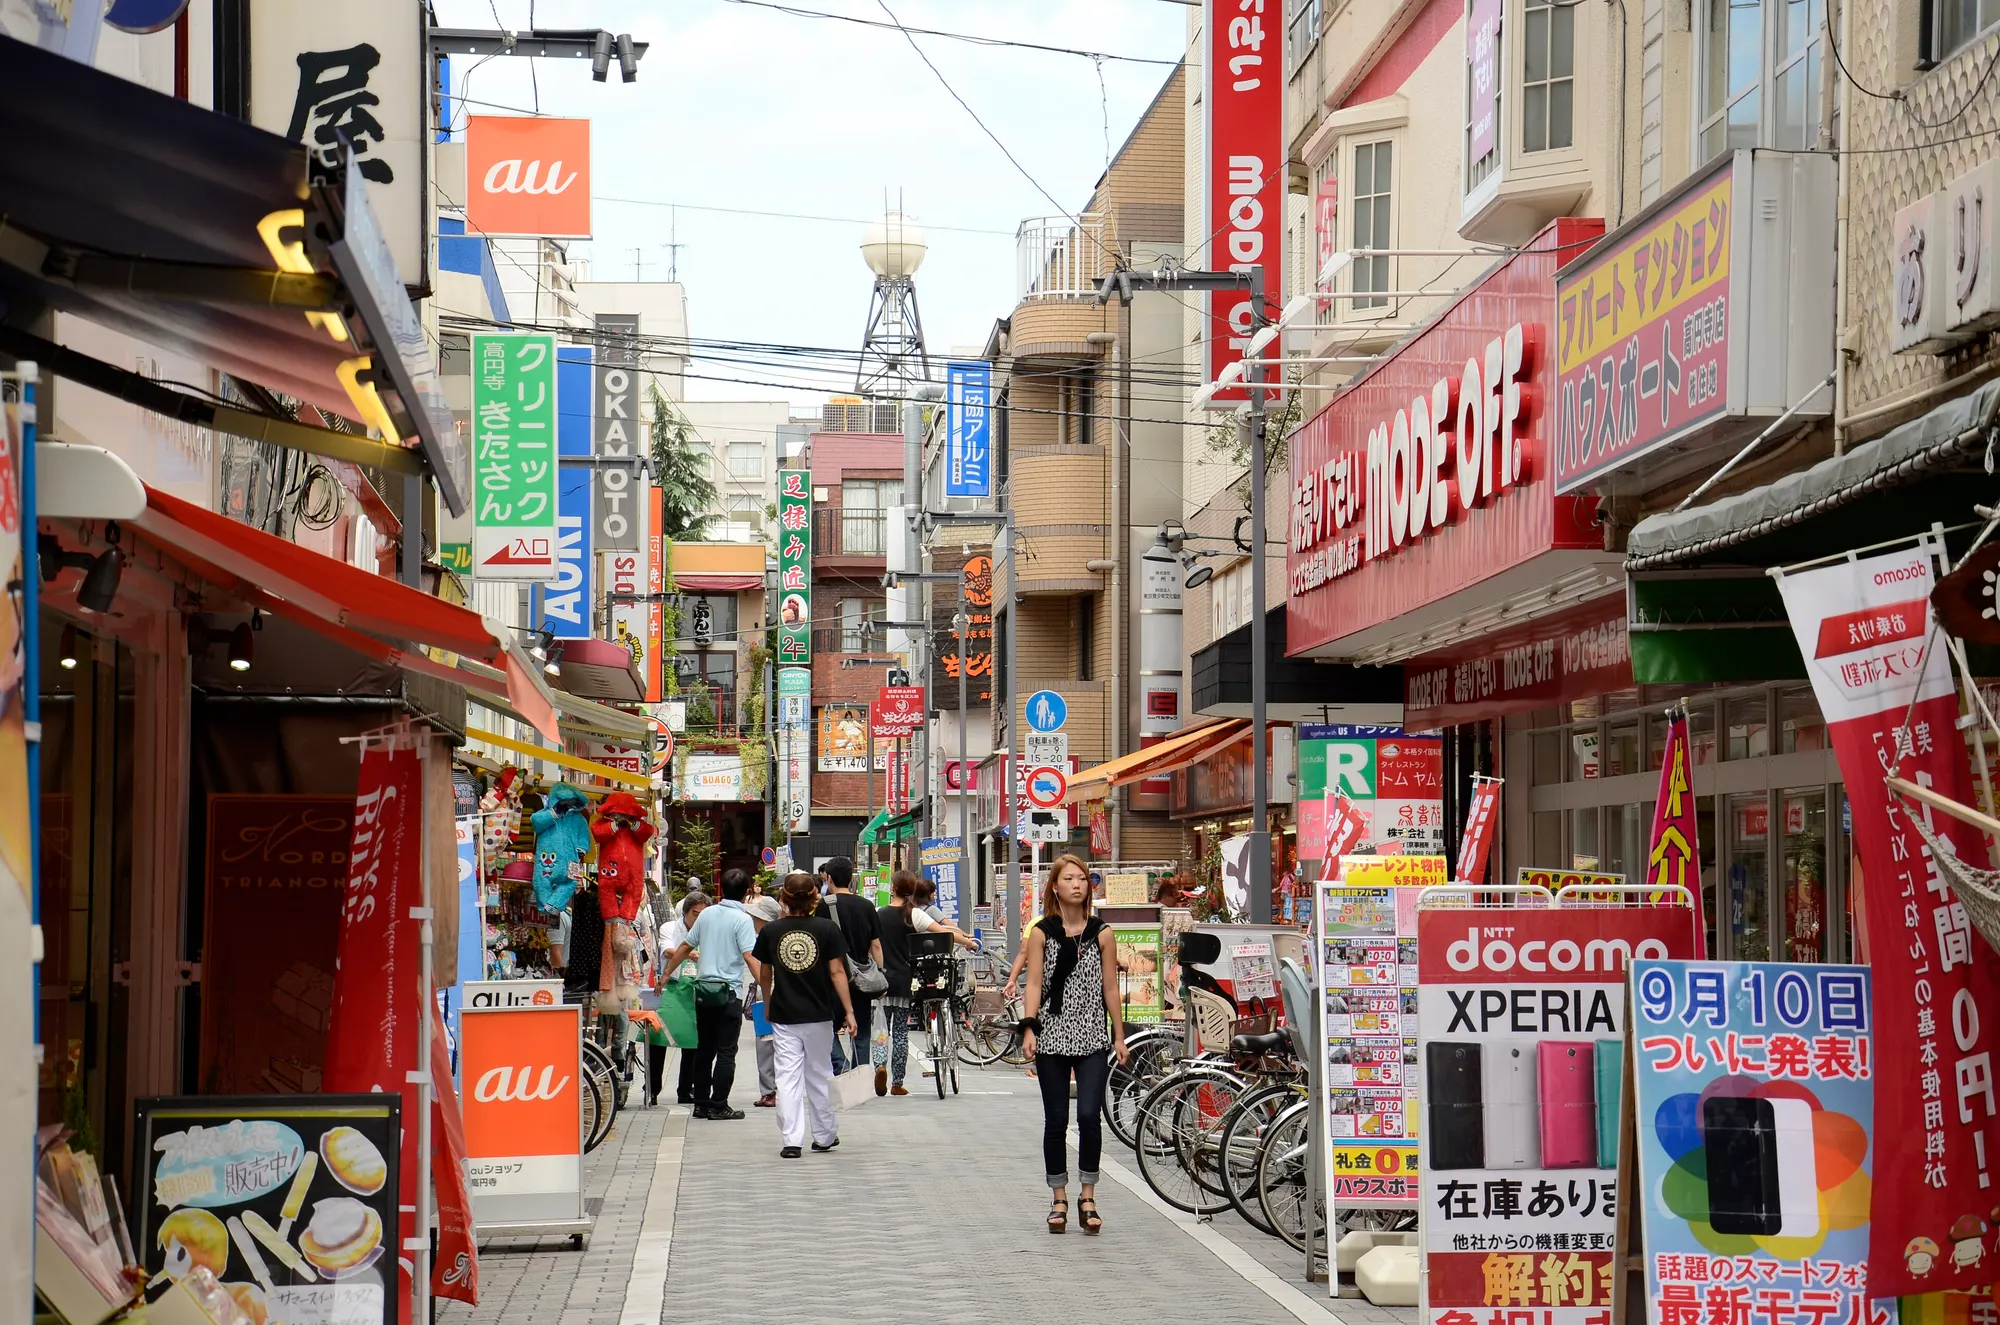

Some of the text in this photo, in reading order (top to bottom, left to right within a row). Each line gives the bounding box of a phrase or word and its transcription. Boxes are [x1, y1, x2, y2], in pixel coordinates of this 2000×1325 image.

[1228, 0, 1265, 92] さい
[1475, 16, 1493, 62] お売り
[1474, 57, 1493, 99] 下さい
[287, 43, 394, 185] 屋
[483, 158, 578, 195] au
[1562, 196, 1728, 366] アパート マンション
[1682, 295, 1726, 362] 高円寺店
[1558, 318, 1681, 477] ハウスポート
[479, 342, 512, 522] 高円寺 きたさん
[516, 343, 549, 522] クリニック
[603, 369, 629, 538] OKAMOTO
[963, 372, 984, 486] 三協アルミ
[1365, 376, 1450, 562] MODE
[1456, 321, 1525, 510] OFF
[1292, 449, 1361, 553] お売り下さい
[516, 538, 549, 556] 入口
[781, 474, 809, 591] 足揉み匠
[1409, 667, 1448, 711] MODE OFF
[1454, 660, 1497, 698] お売り下さい
[1503, 638, 1554, 691] MODE OFF
[1028, 736, 1064, 746] 自転車を除く
[1338, 727, 1348, 736] US
[835, 757, 867, 768] ¥1,470
[1326, 743, 1373, 795] R
[1446, 926, 1669, 972] docomo
[1483, 927, 1515, 938] NTT
[1447, 989, 1612, 1033] XPERIA
[1640, 967, 1869, 1033] 9月10日
[1641, 1031, 1872, 1081] ついに発表!
[474, 1064, 571, 1103] au
[225, 1146, 299, 1198] 販売中!
[470, 1163, 523, 1176] auショップ
[471, 1178, 497, 1188] 高円寺
[1481, 1252, 1612, 1308] 解約
